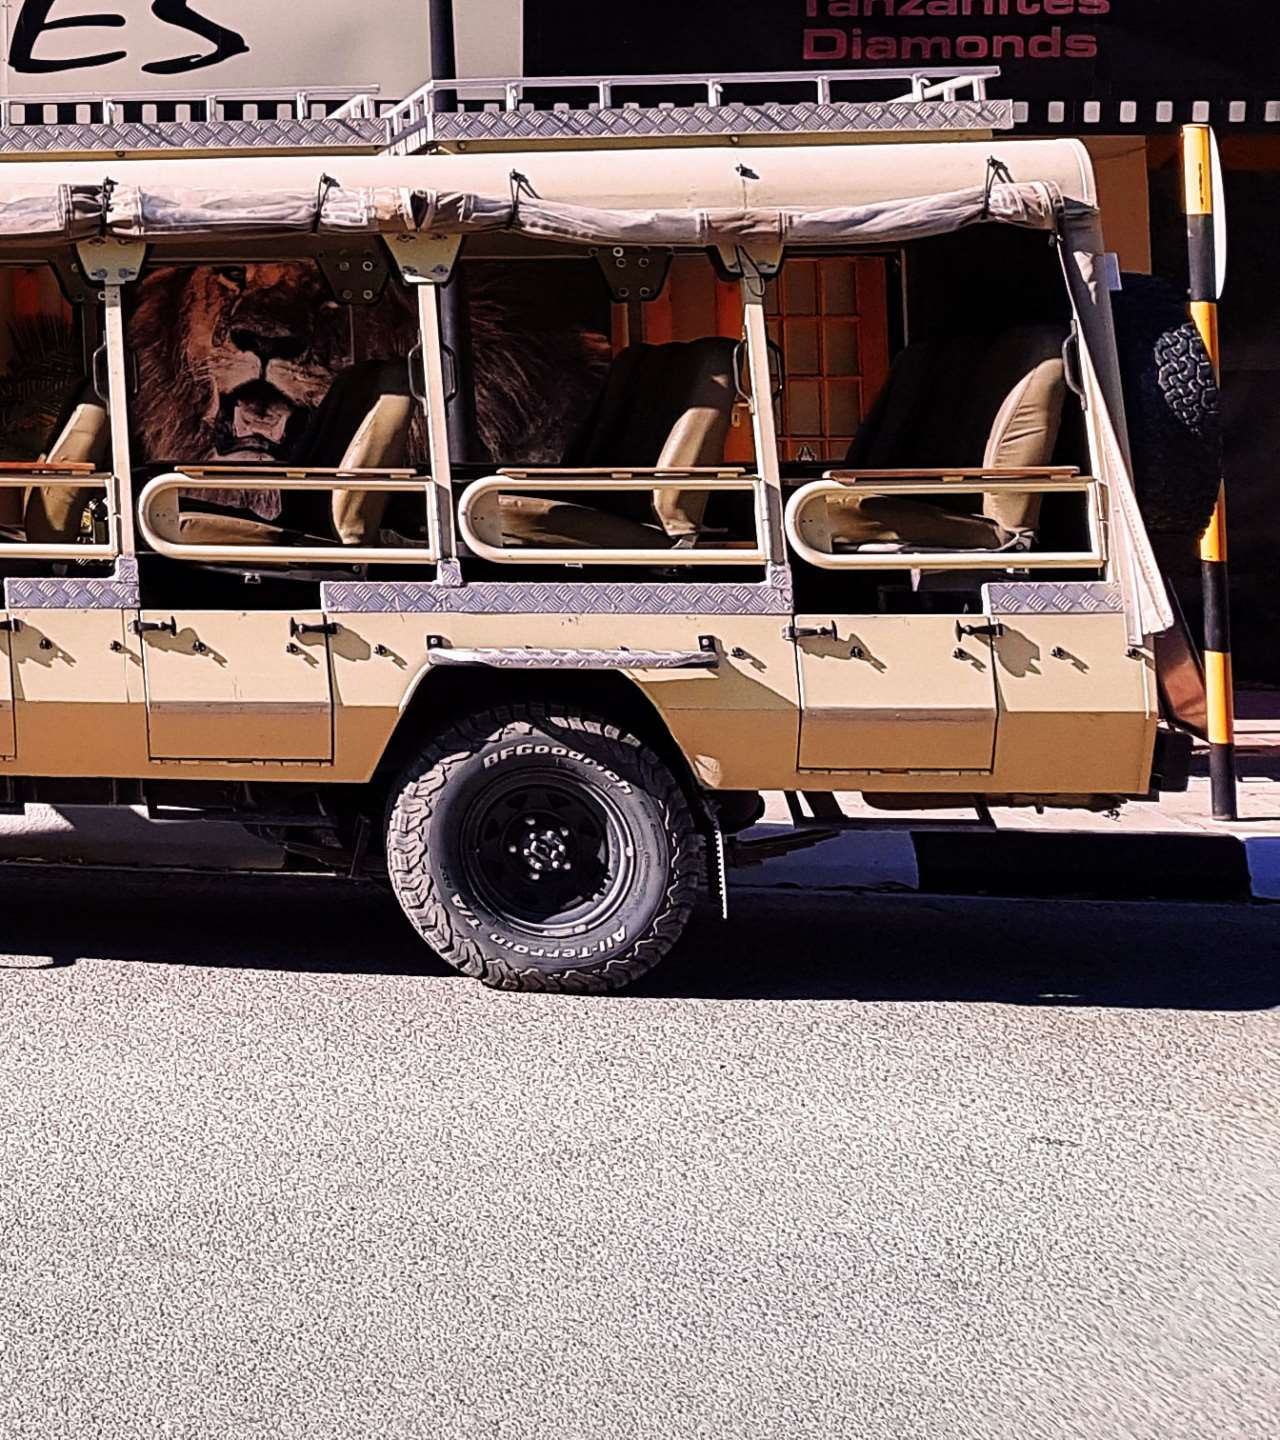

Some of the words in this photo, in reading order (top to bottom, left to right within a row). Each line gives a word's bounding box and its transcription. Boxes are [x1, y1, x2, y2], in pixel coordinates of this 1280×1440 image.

[802, 26, 1098, 60] Diamonds
[483, 744, 633, 795] BFGoodrich
[490, 926, 627, 959] All-Terrain
